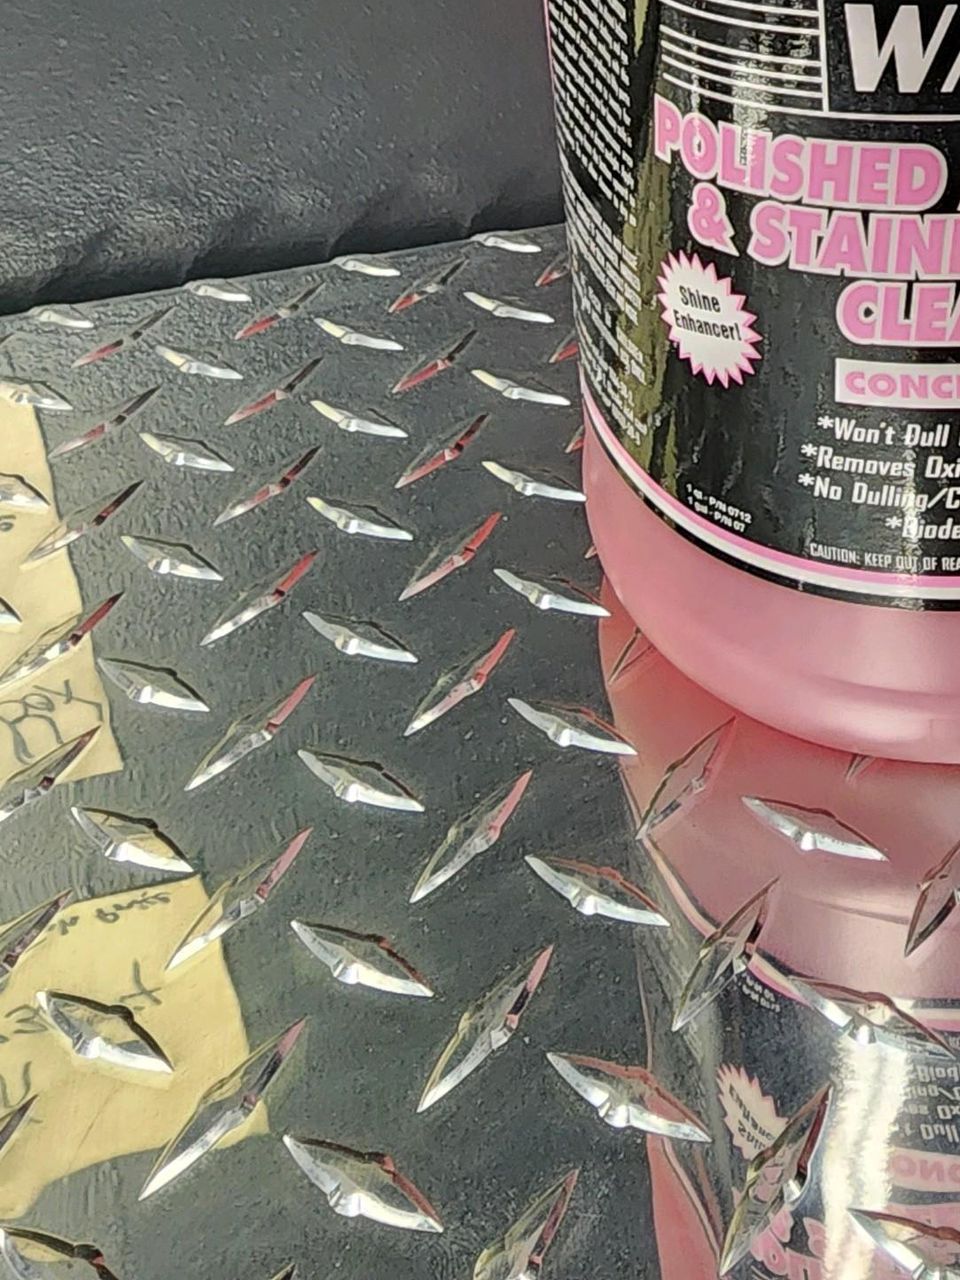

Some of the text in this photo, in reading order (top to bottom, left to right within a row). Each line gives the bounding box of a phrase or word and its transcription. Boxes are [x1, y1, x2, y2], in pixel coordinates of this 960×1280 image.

[654, 93, 948, 212] POLISHED
[688, 182, 739, 258] &
[679, 285, 721, 313] Shine
[673, 309, 742, 341] Enhancer!
[903, 423, 950, 448] Dull
[809, 542, 861, 565] CAUTION:
[864, 551, 892, 569] KEEP
[896, 556, 918, 571] OUT
[923, 556, 938, 570] OF
